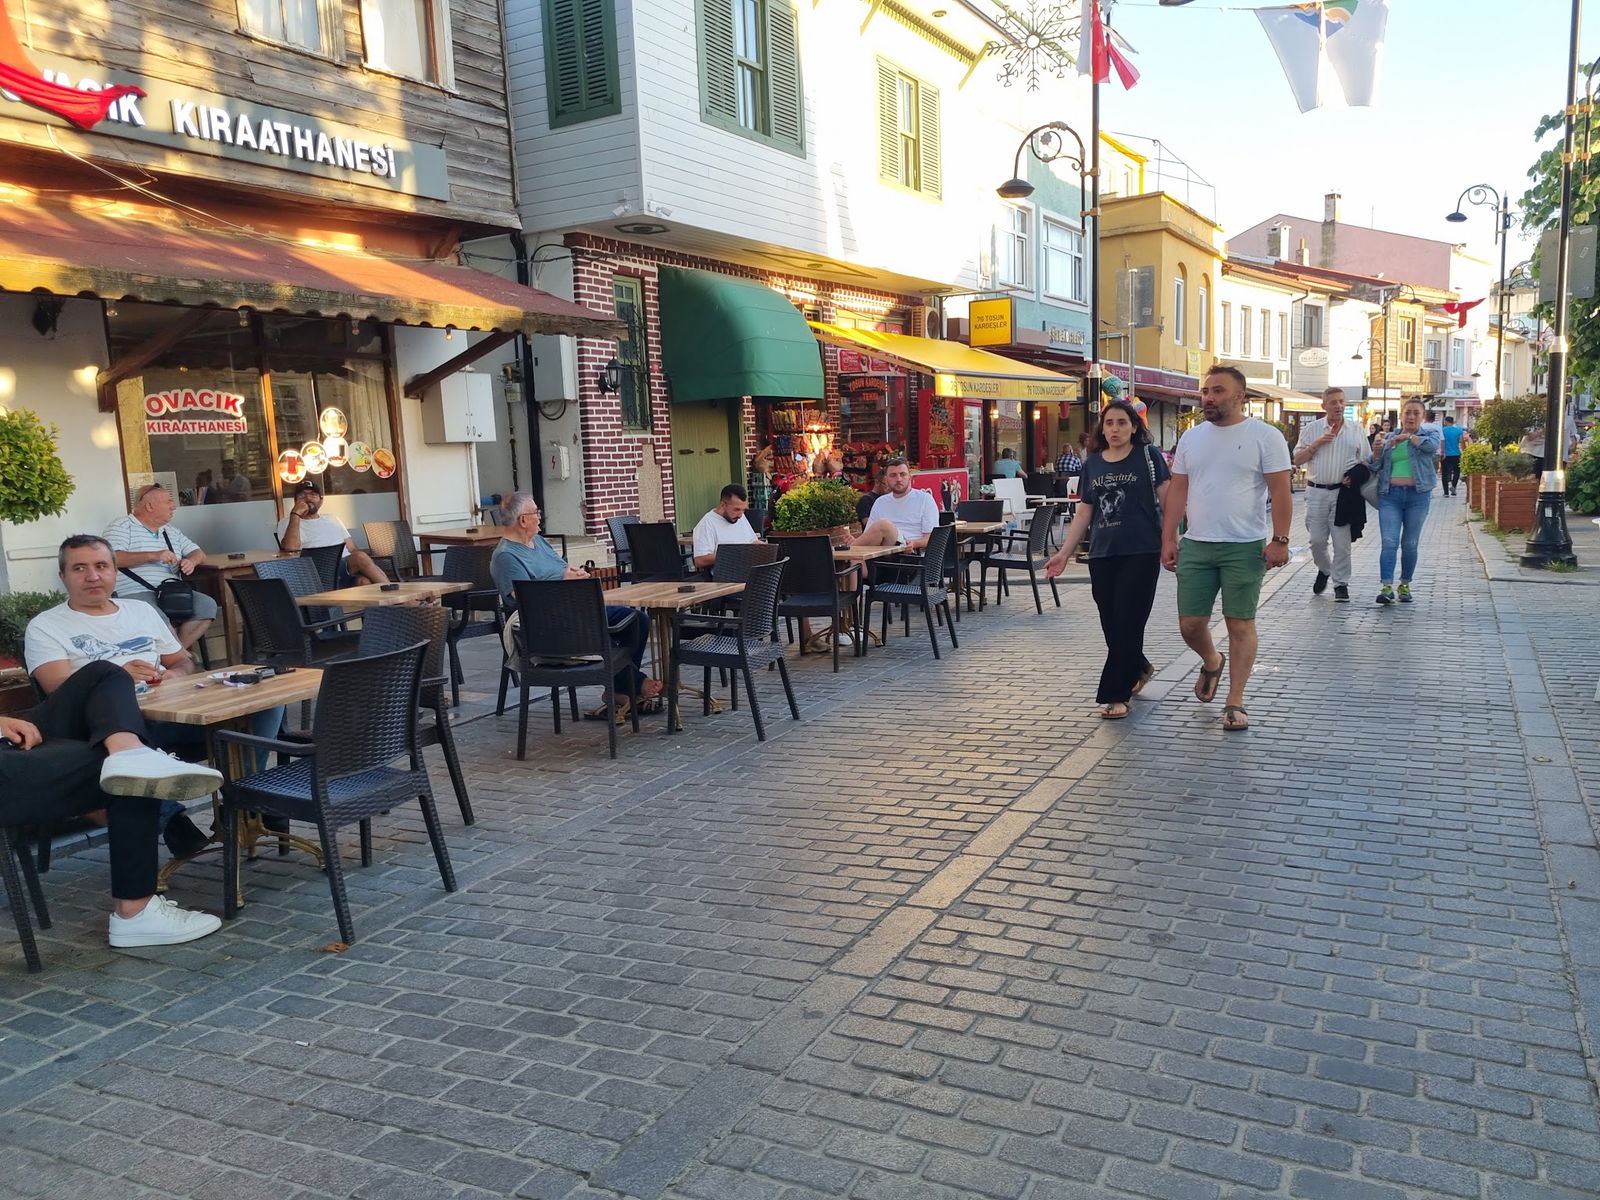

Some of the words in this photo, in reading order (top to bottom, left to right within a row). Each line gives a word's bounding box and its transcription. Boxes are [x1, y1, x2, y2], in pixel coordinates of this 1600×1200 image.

[170, 99, 397, 178] KIRAATHANESİ
[974, 321, 1008, 330] KARDEŞLER
[146, 391, 240, 414] OVACIK
[146, 418, 246, 433] KIRAATHANESİ
